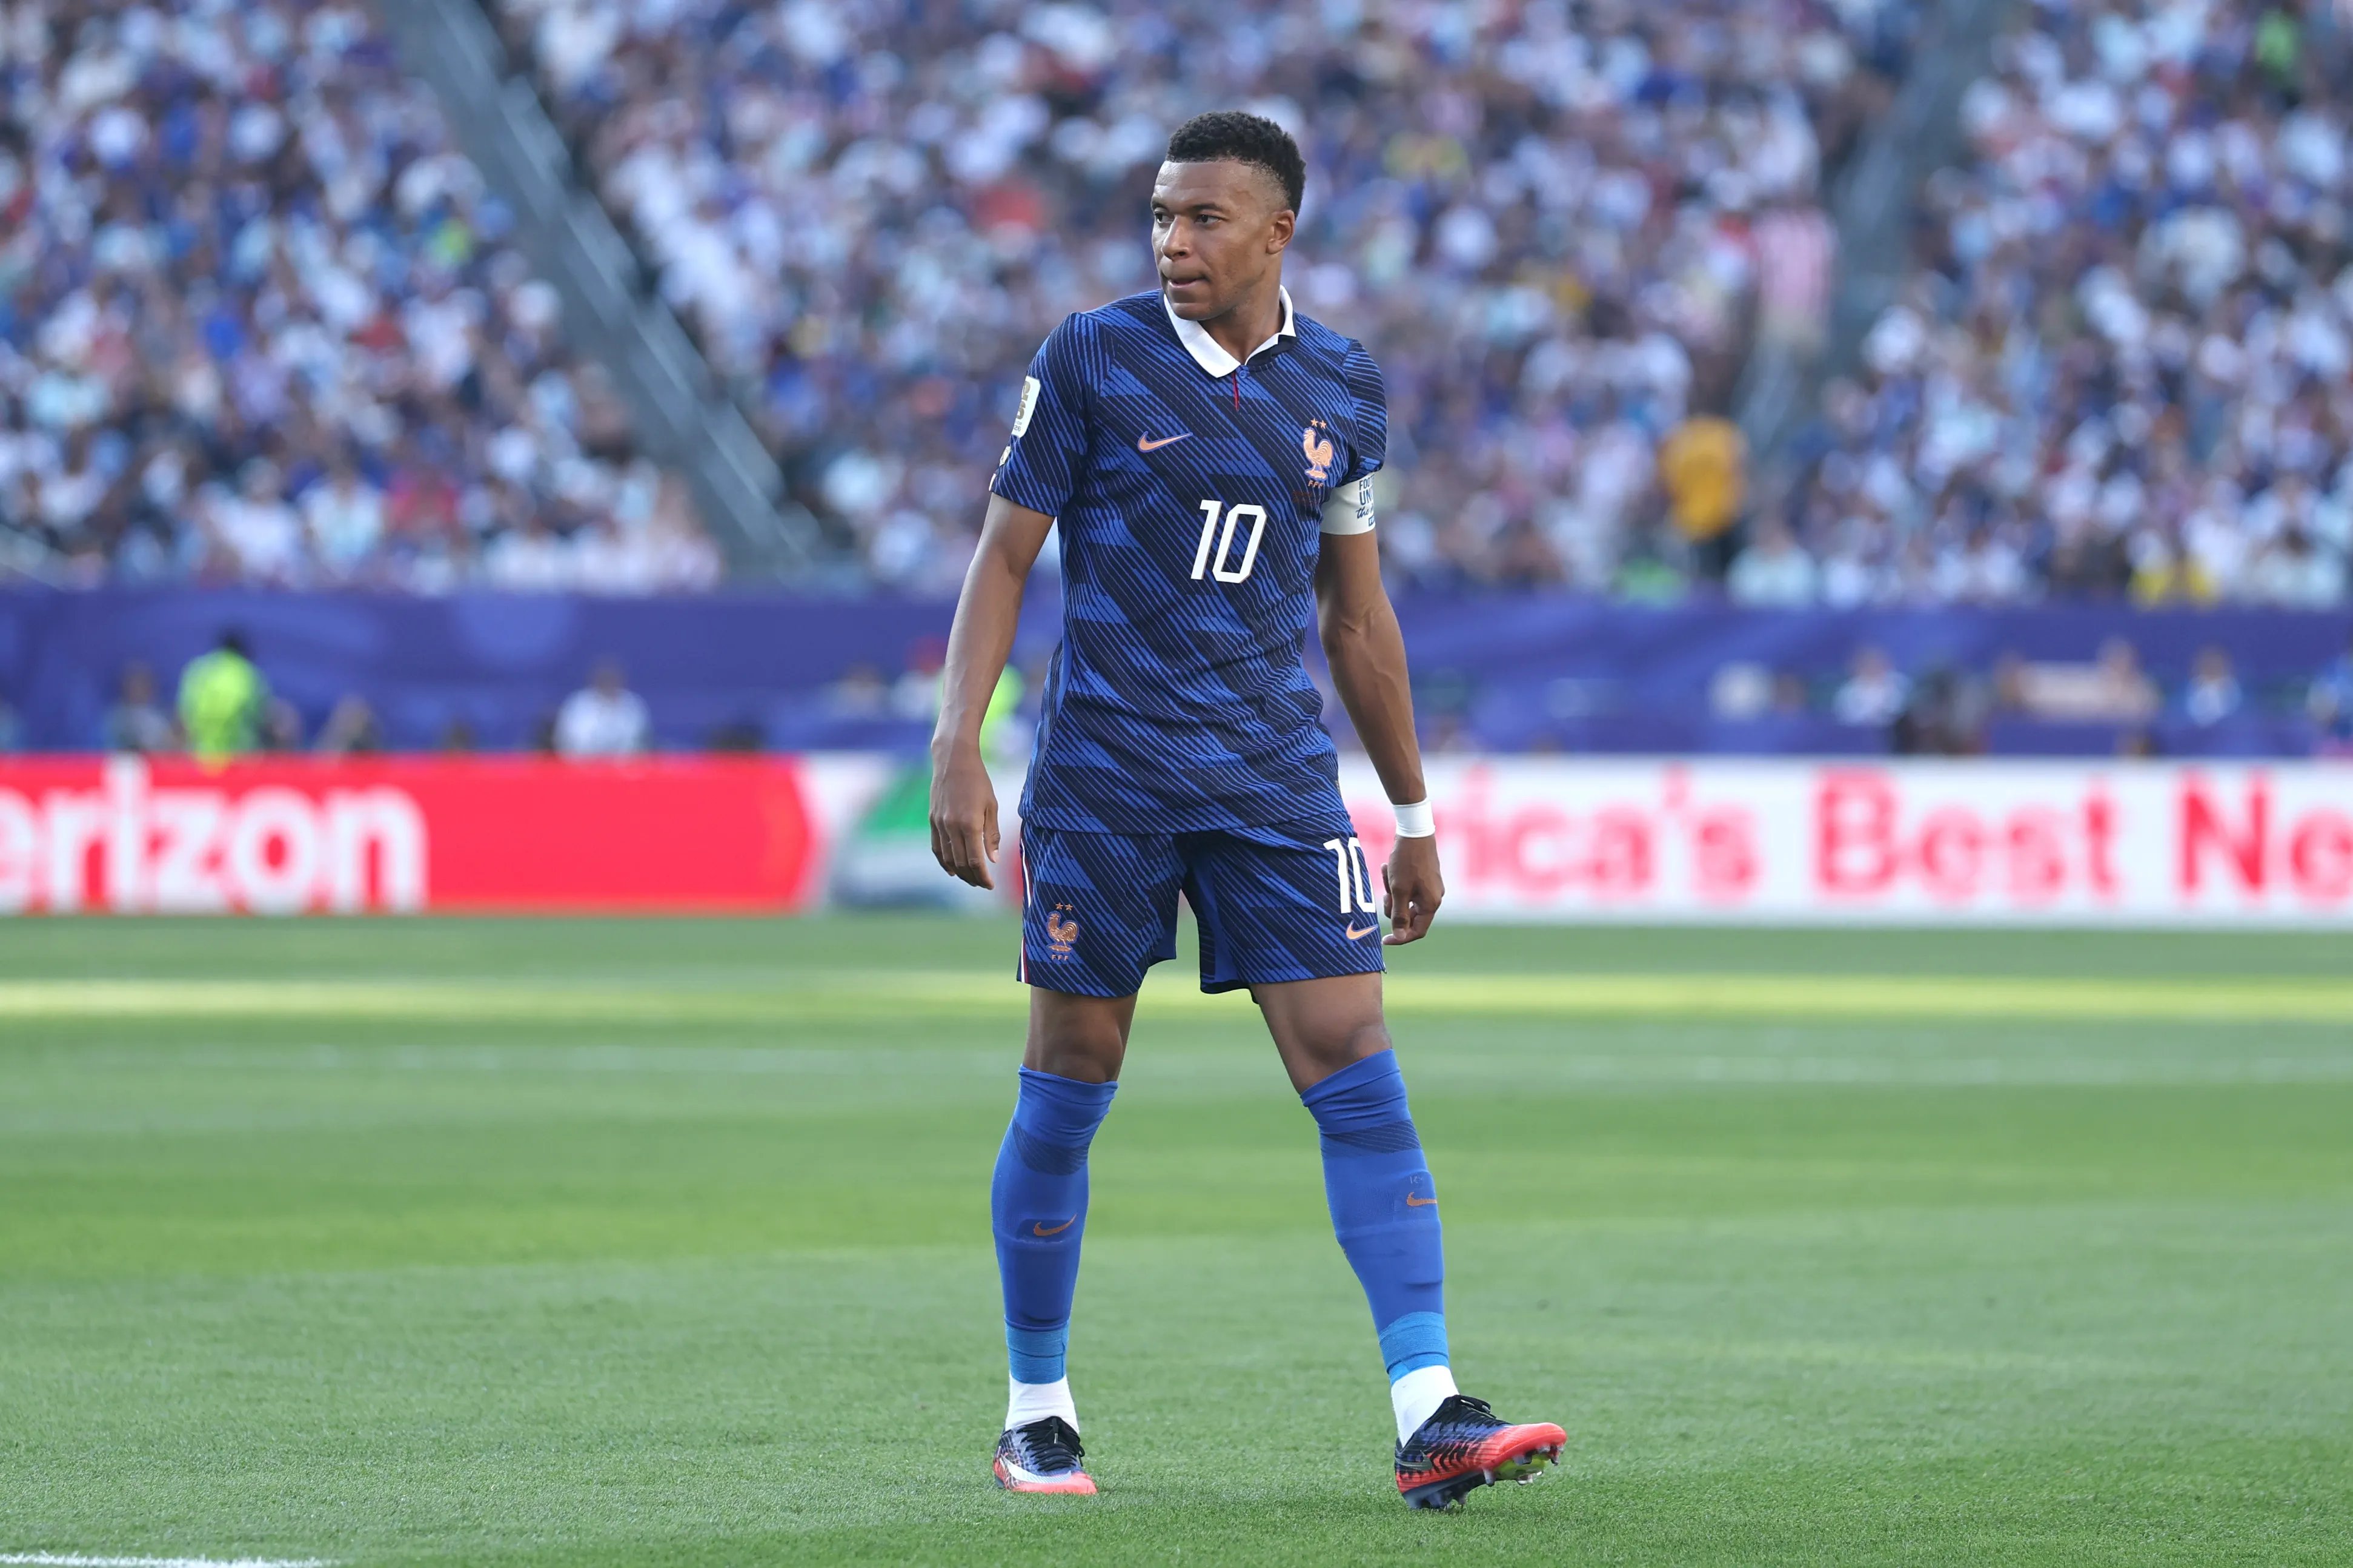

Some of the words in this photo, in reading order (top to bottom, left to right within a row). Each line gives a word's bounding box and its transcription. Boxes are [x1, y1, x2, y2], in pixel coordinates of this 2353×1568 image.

[1307, 480, 1324, 489] FFF
[1190, 499, 1267, 584] 10
[1814, 764, 2117, 904] Best
[1323, 837, 1376, 913] 10
